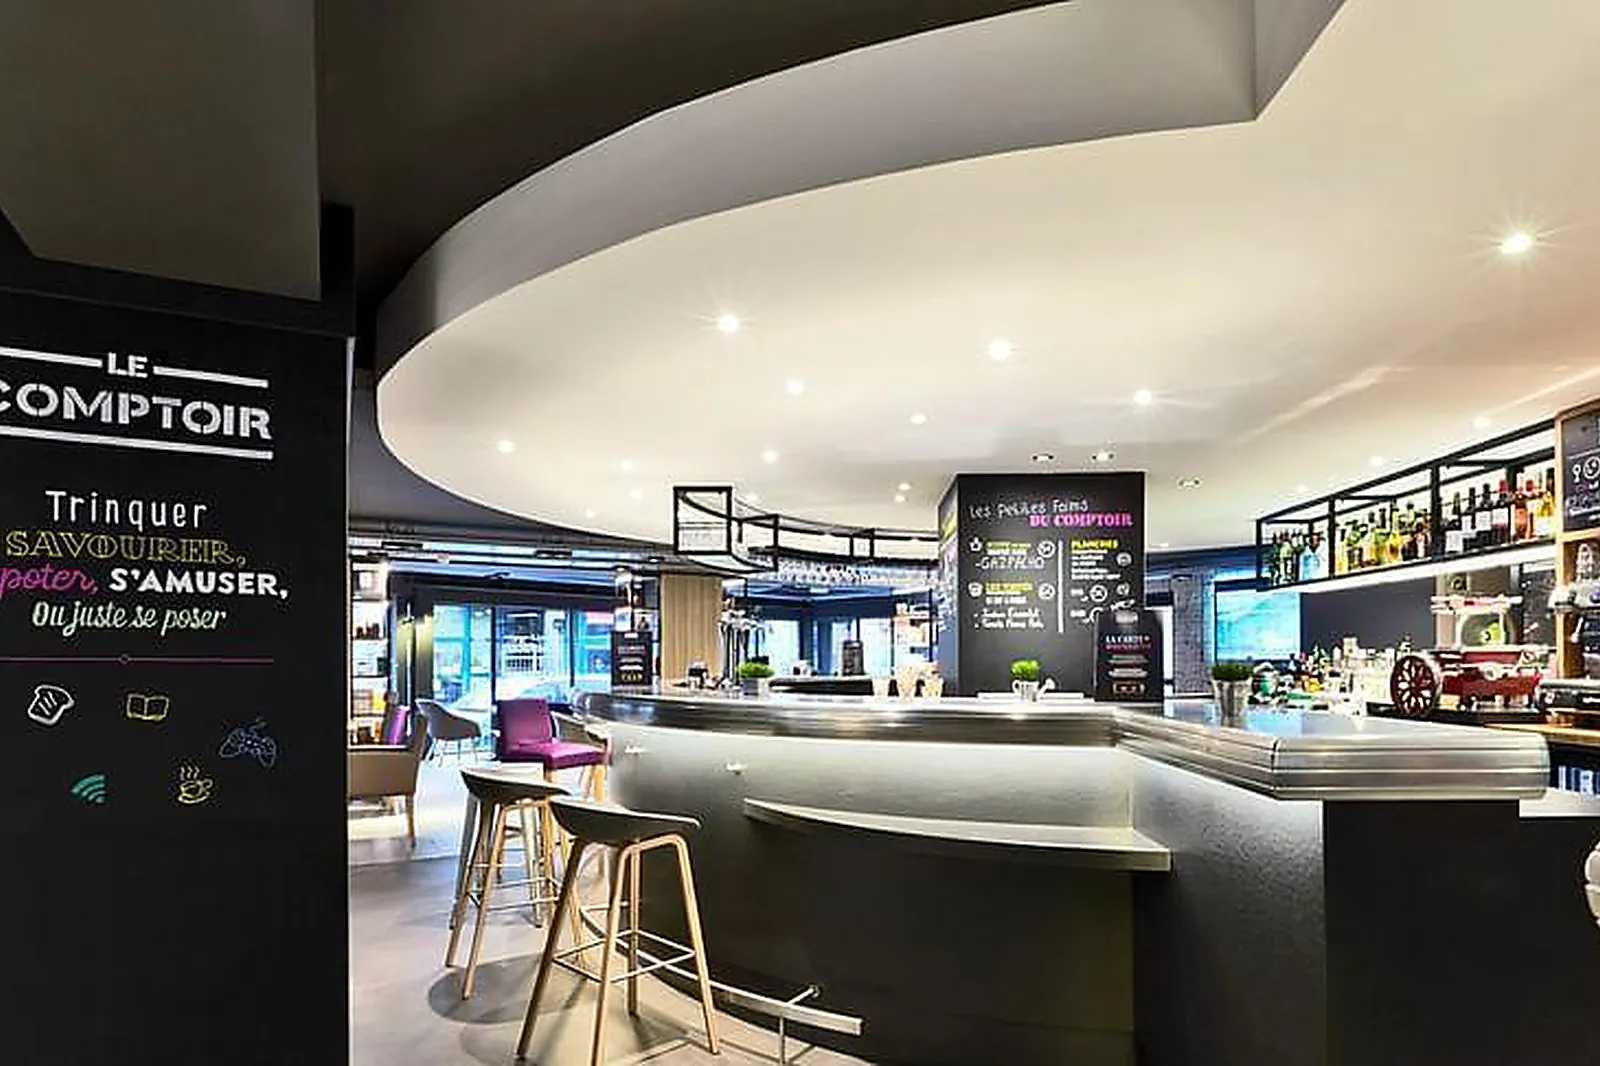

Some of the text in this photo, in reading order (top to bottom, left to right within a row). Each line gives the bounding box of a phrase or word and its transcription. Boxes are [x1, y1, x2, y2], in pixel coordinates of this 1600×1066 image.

[107, 352, 148, 378] LE
[45, 490, 208, 532] Trinquer
[1054, 513, 1134, 528] COMPTOIR
[5, 529, 247, 567] SAVOURER,
[108, 567, 290, 599] S'AMUSER,
[31, 600, 228, 637] Ou juste se poser
